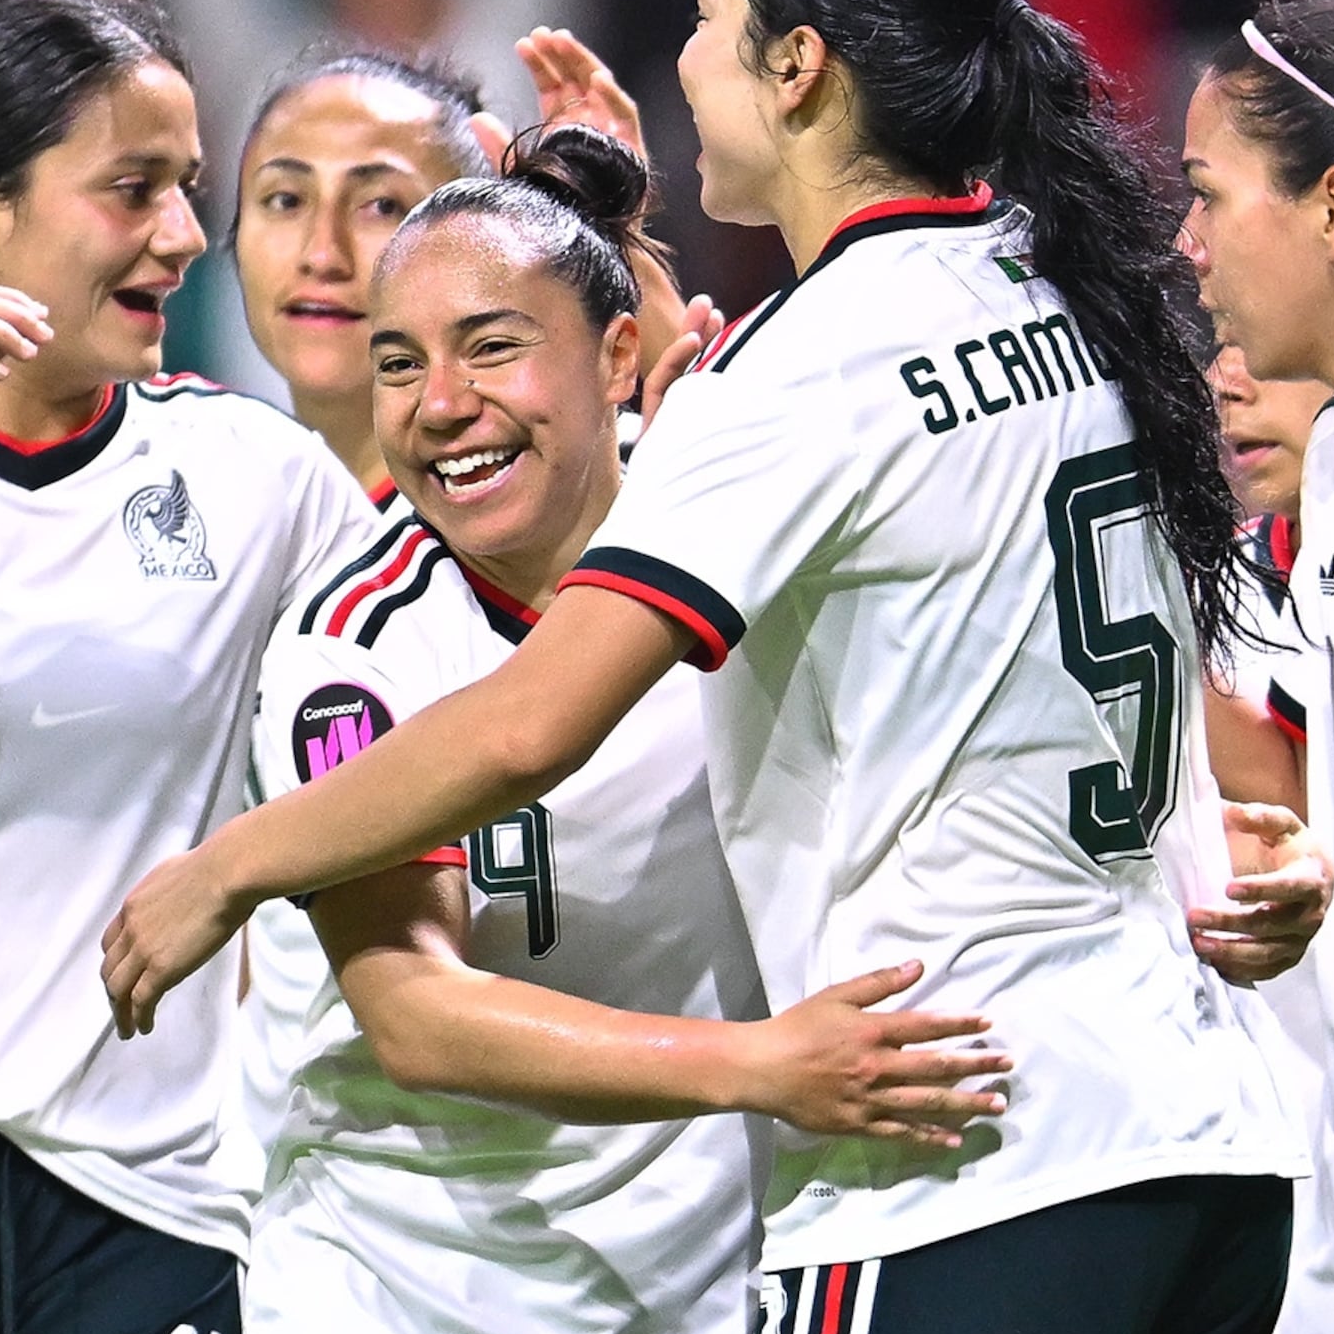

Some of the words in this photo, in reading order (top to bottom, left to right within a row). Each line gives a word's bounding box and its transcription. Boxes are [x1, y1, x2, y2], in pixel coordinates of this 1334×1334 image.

[900, 312, 1120, 435] S.CAM
[302, 699, 364, 722] Concacaf
[1044, 441, 1185, 863] 5
[468, 801, 561, 961] 9
